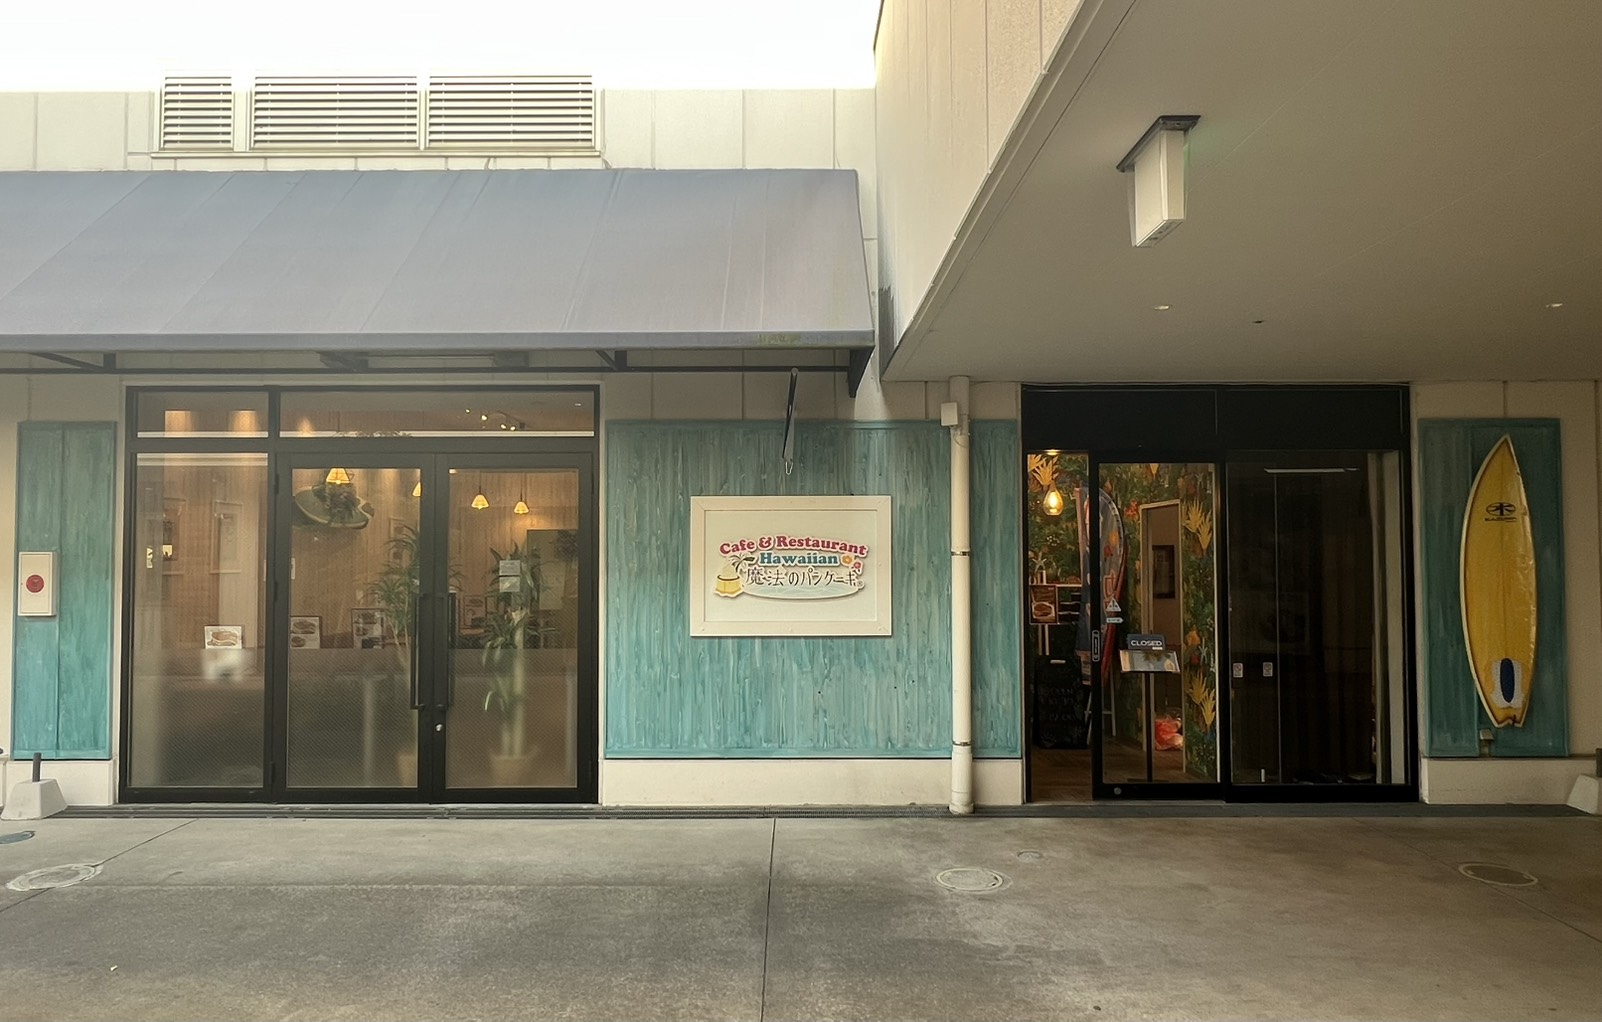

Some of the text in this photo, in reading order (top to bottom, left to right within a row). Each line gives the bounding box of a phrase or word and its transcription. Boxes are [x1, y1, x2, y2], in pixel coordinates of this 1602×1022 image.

[719, 535, 867, 556] Cafe & Restaurant
[759, 552, 838, 565] Hawaiian
